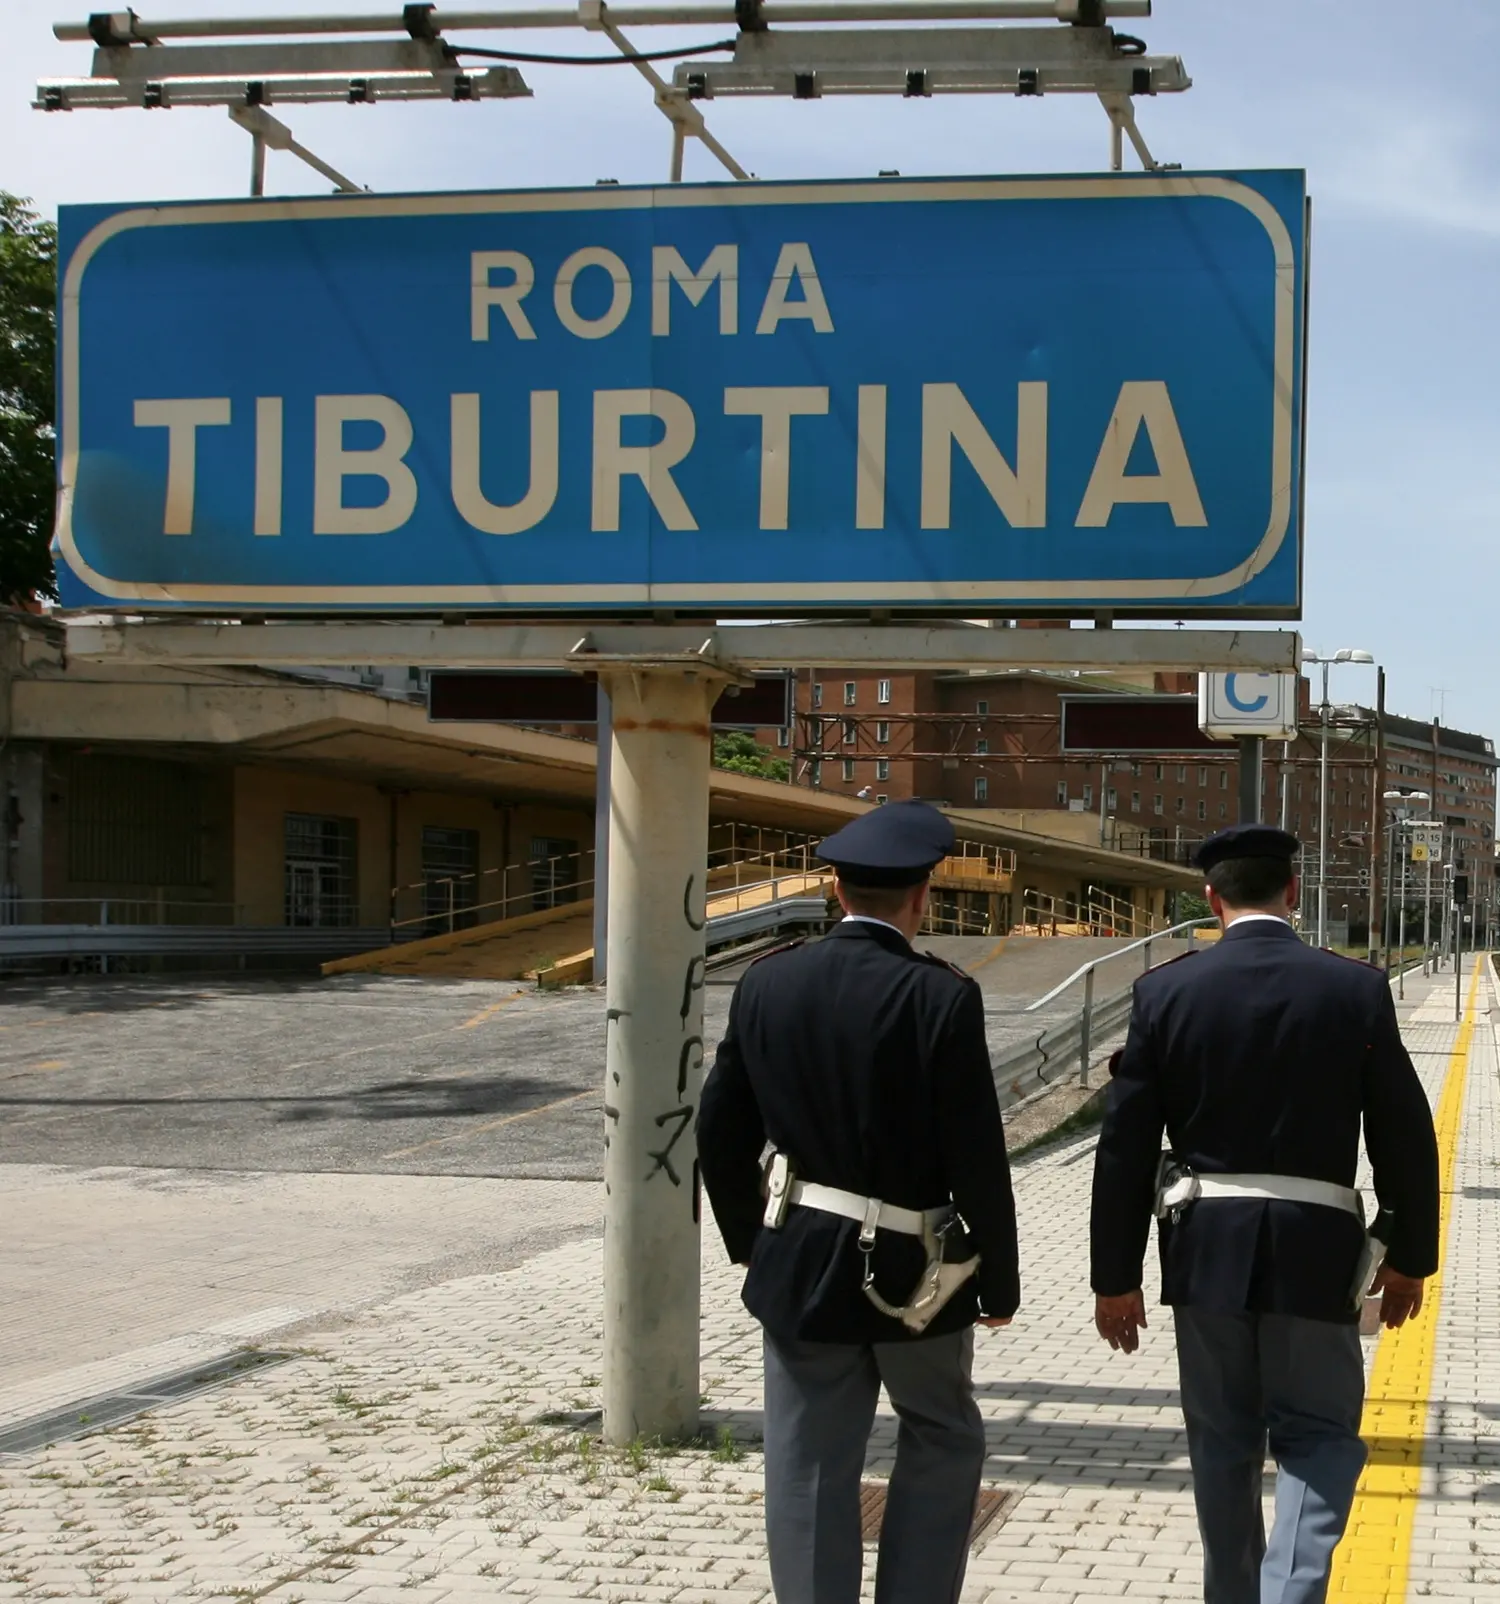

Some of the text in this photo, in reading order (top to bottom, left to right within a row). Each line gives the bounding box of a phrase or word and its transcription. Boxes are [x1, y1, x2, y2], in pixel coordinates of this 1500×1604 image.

[471, 241, 835, 341] ROMA
[133, 380, 1209, 536] TIBURTINA
[1224, 672, 1270, 713] C
[1416, 833, 1440, 843] 12 15
[1416, 849, 1423, 857] 9
